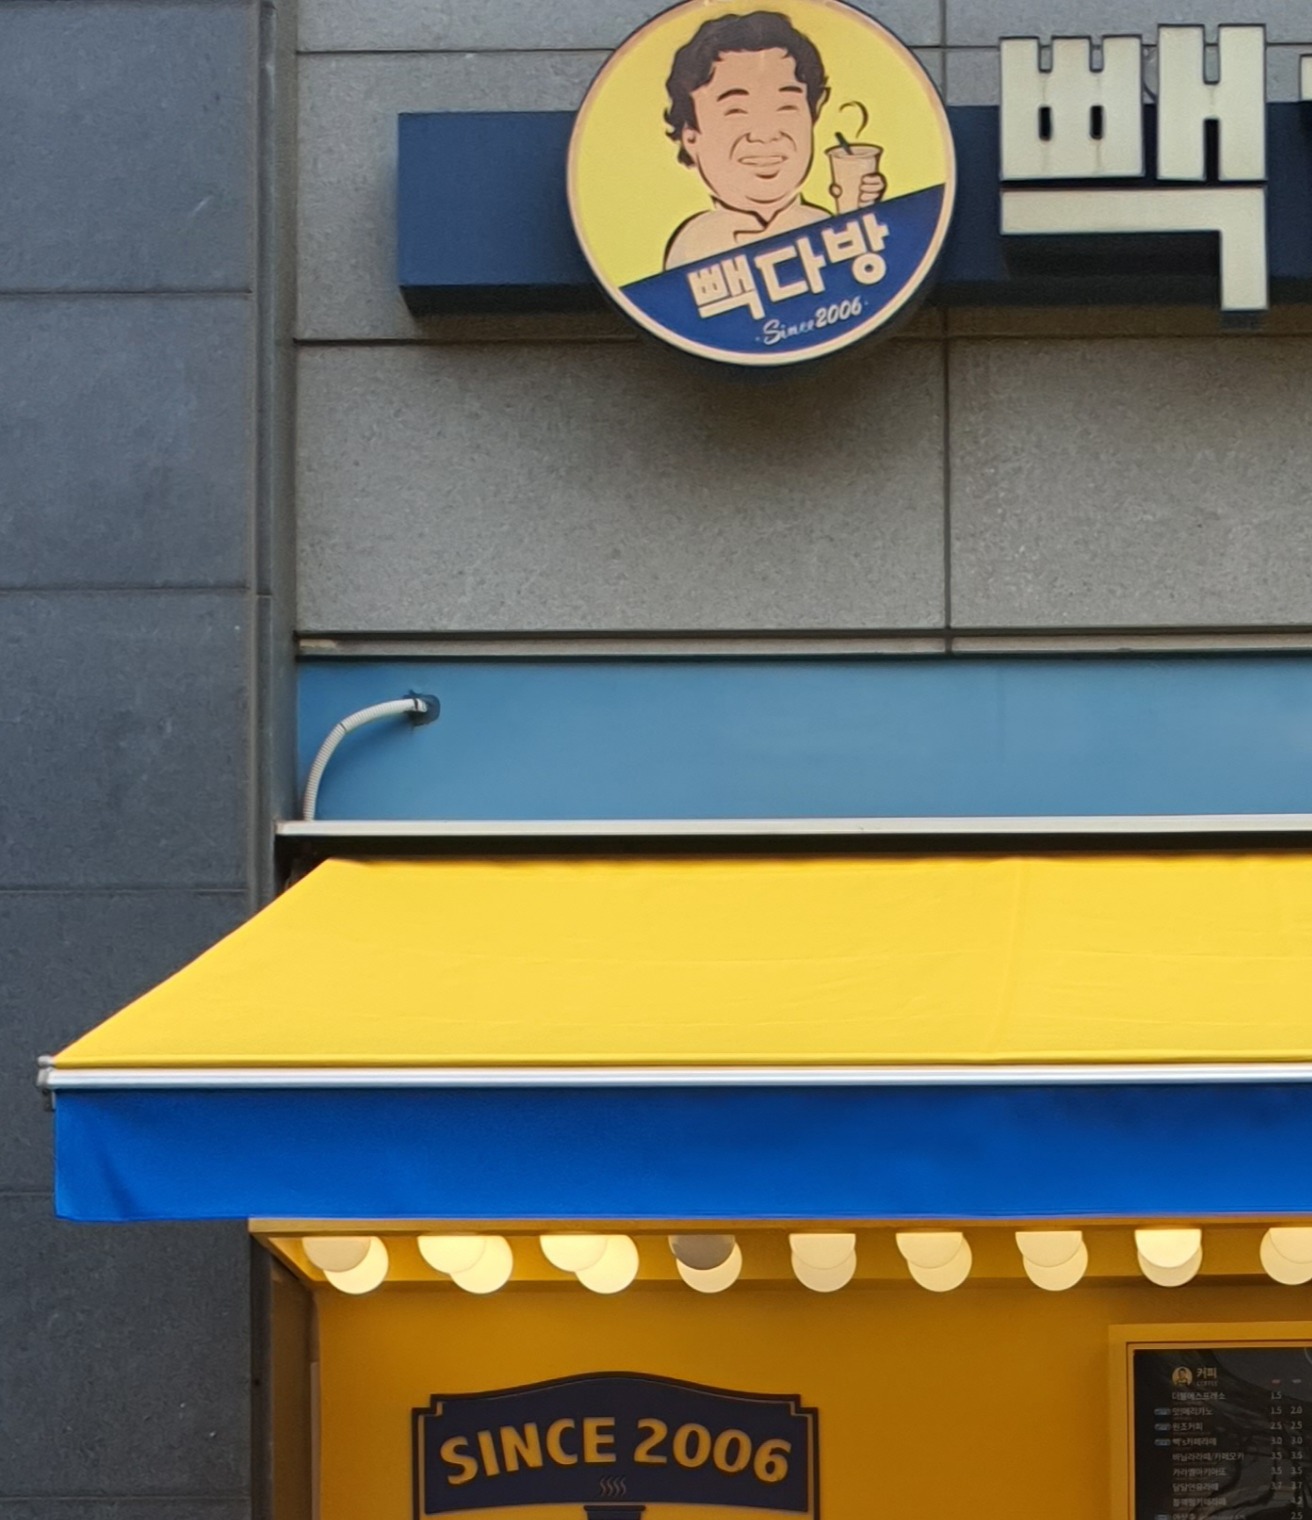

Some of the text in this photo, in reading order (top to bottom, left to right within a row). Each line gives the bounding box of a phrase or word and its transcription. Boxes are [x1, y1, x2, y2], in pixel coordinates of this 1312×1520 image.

[688, 213, 890, 320] 빽다방
[815, 296, 862, 328] 2006
[1196, 1367, 1217, 1379] 커피
[440, 1416, 792, 1485] SINCE 2006
